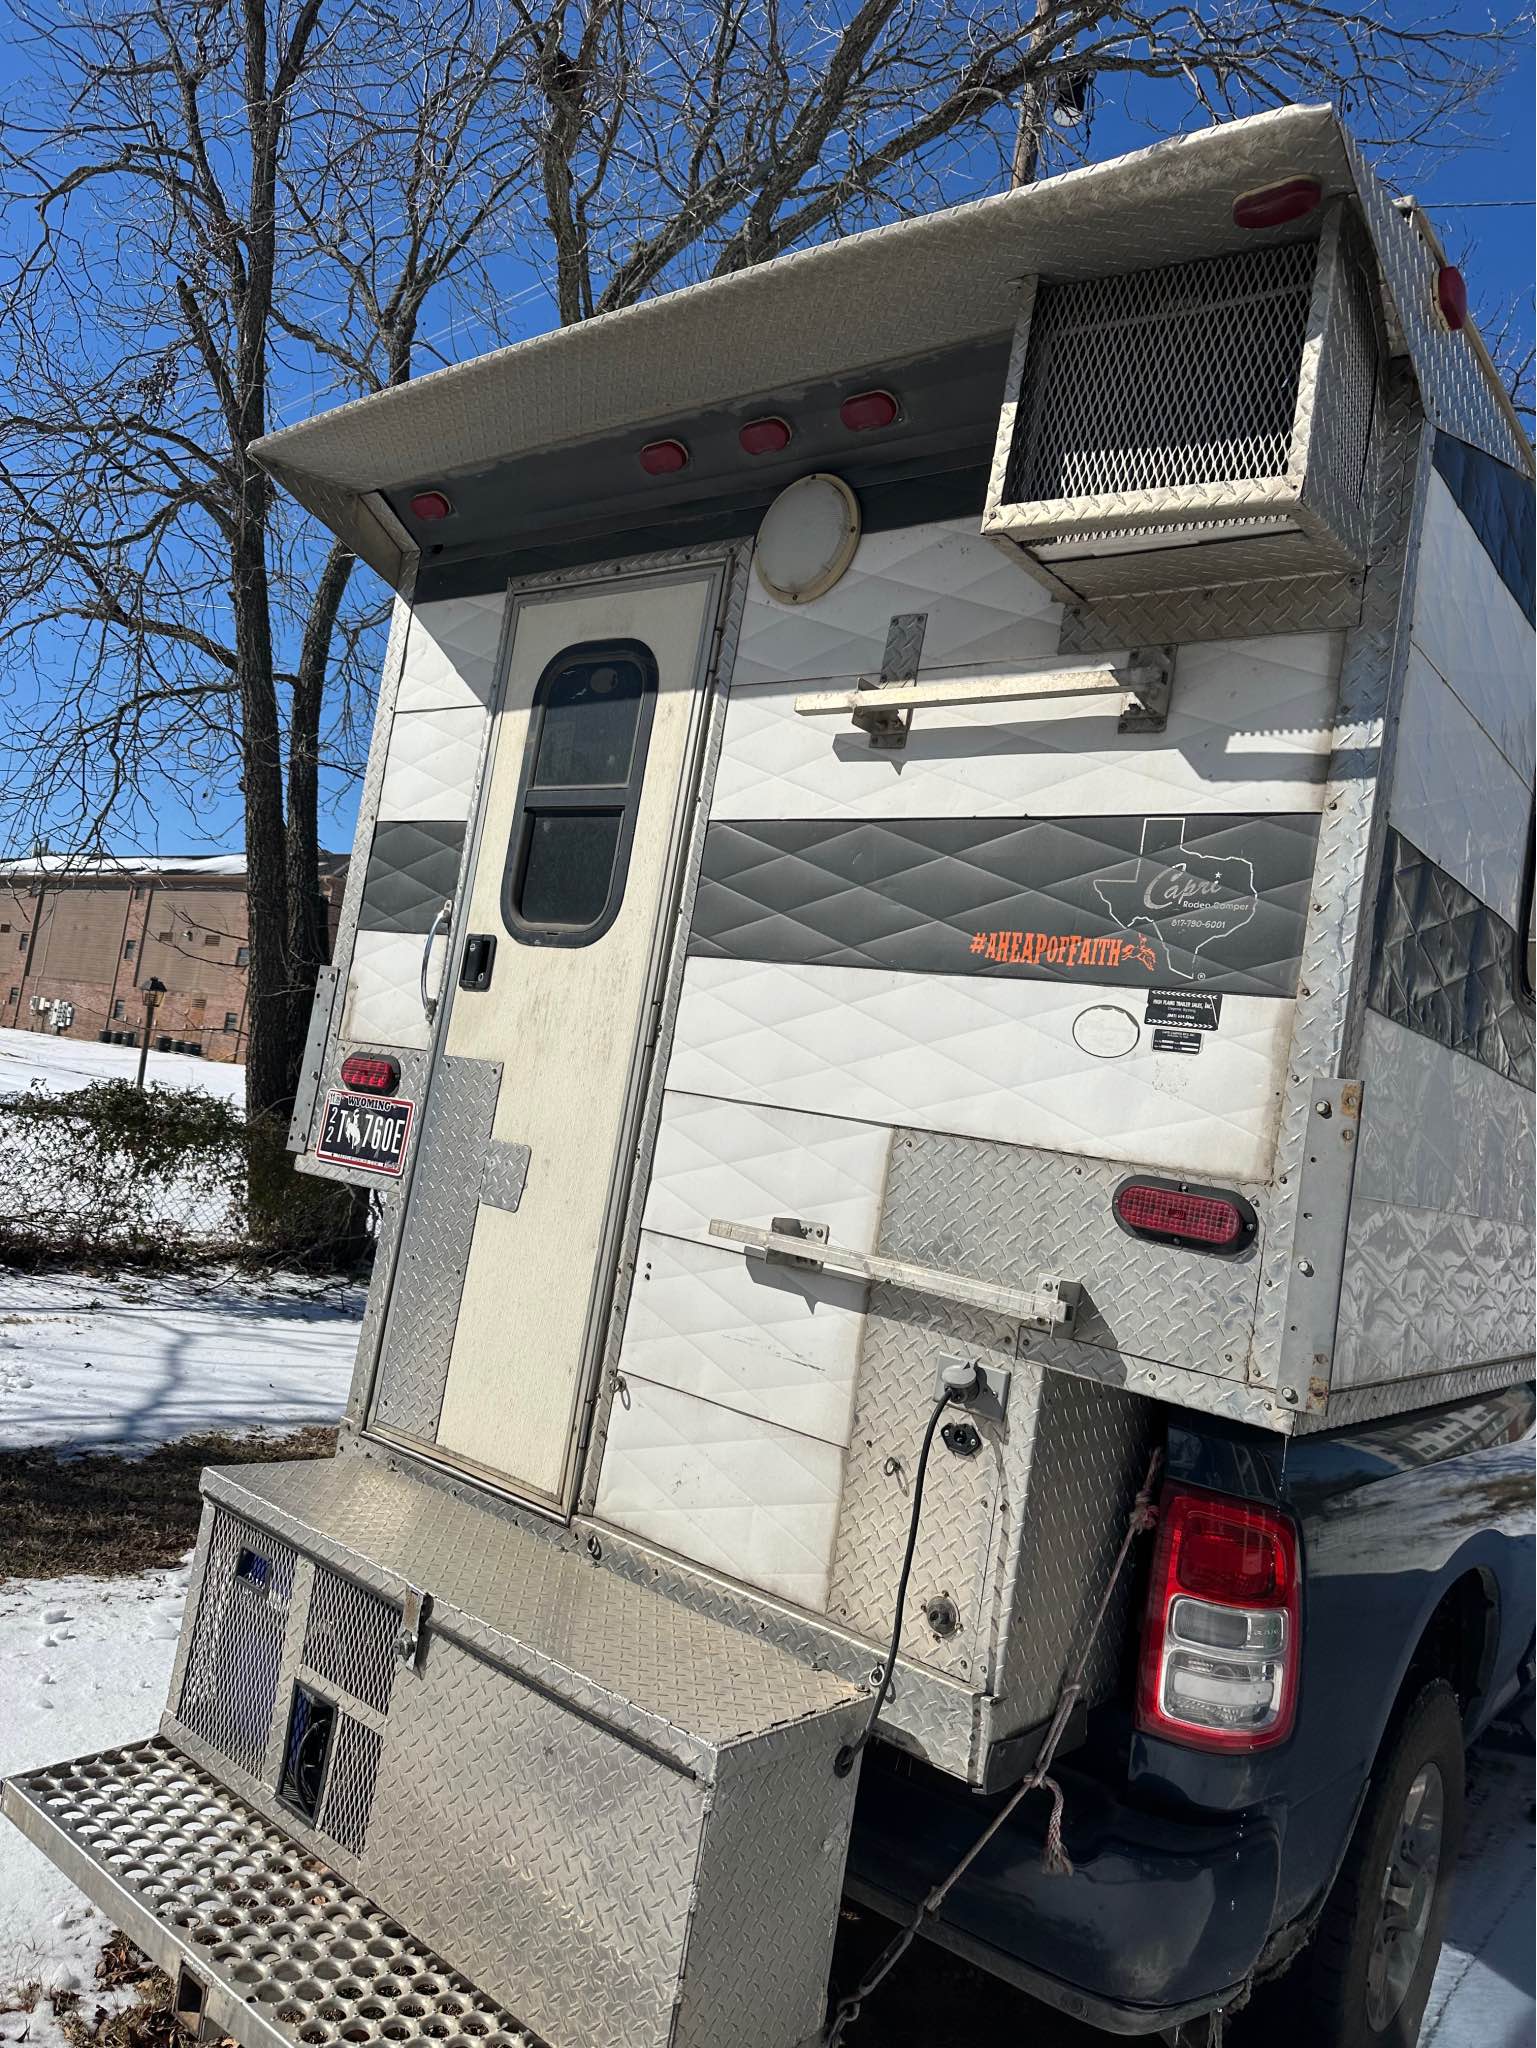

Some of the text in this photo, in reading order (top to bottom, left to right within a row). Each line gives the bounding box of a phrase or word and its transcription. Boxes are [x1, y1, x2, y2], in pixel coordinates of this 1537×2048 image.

[1143, 862, 1222, 910] Capri
[1182, 900, 1250, 913] Rodeo Camper
[348, 1096, 392, 1112] WYOMING
